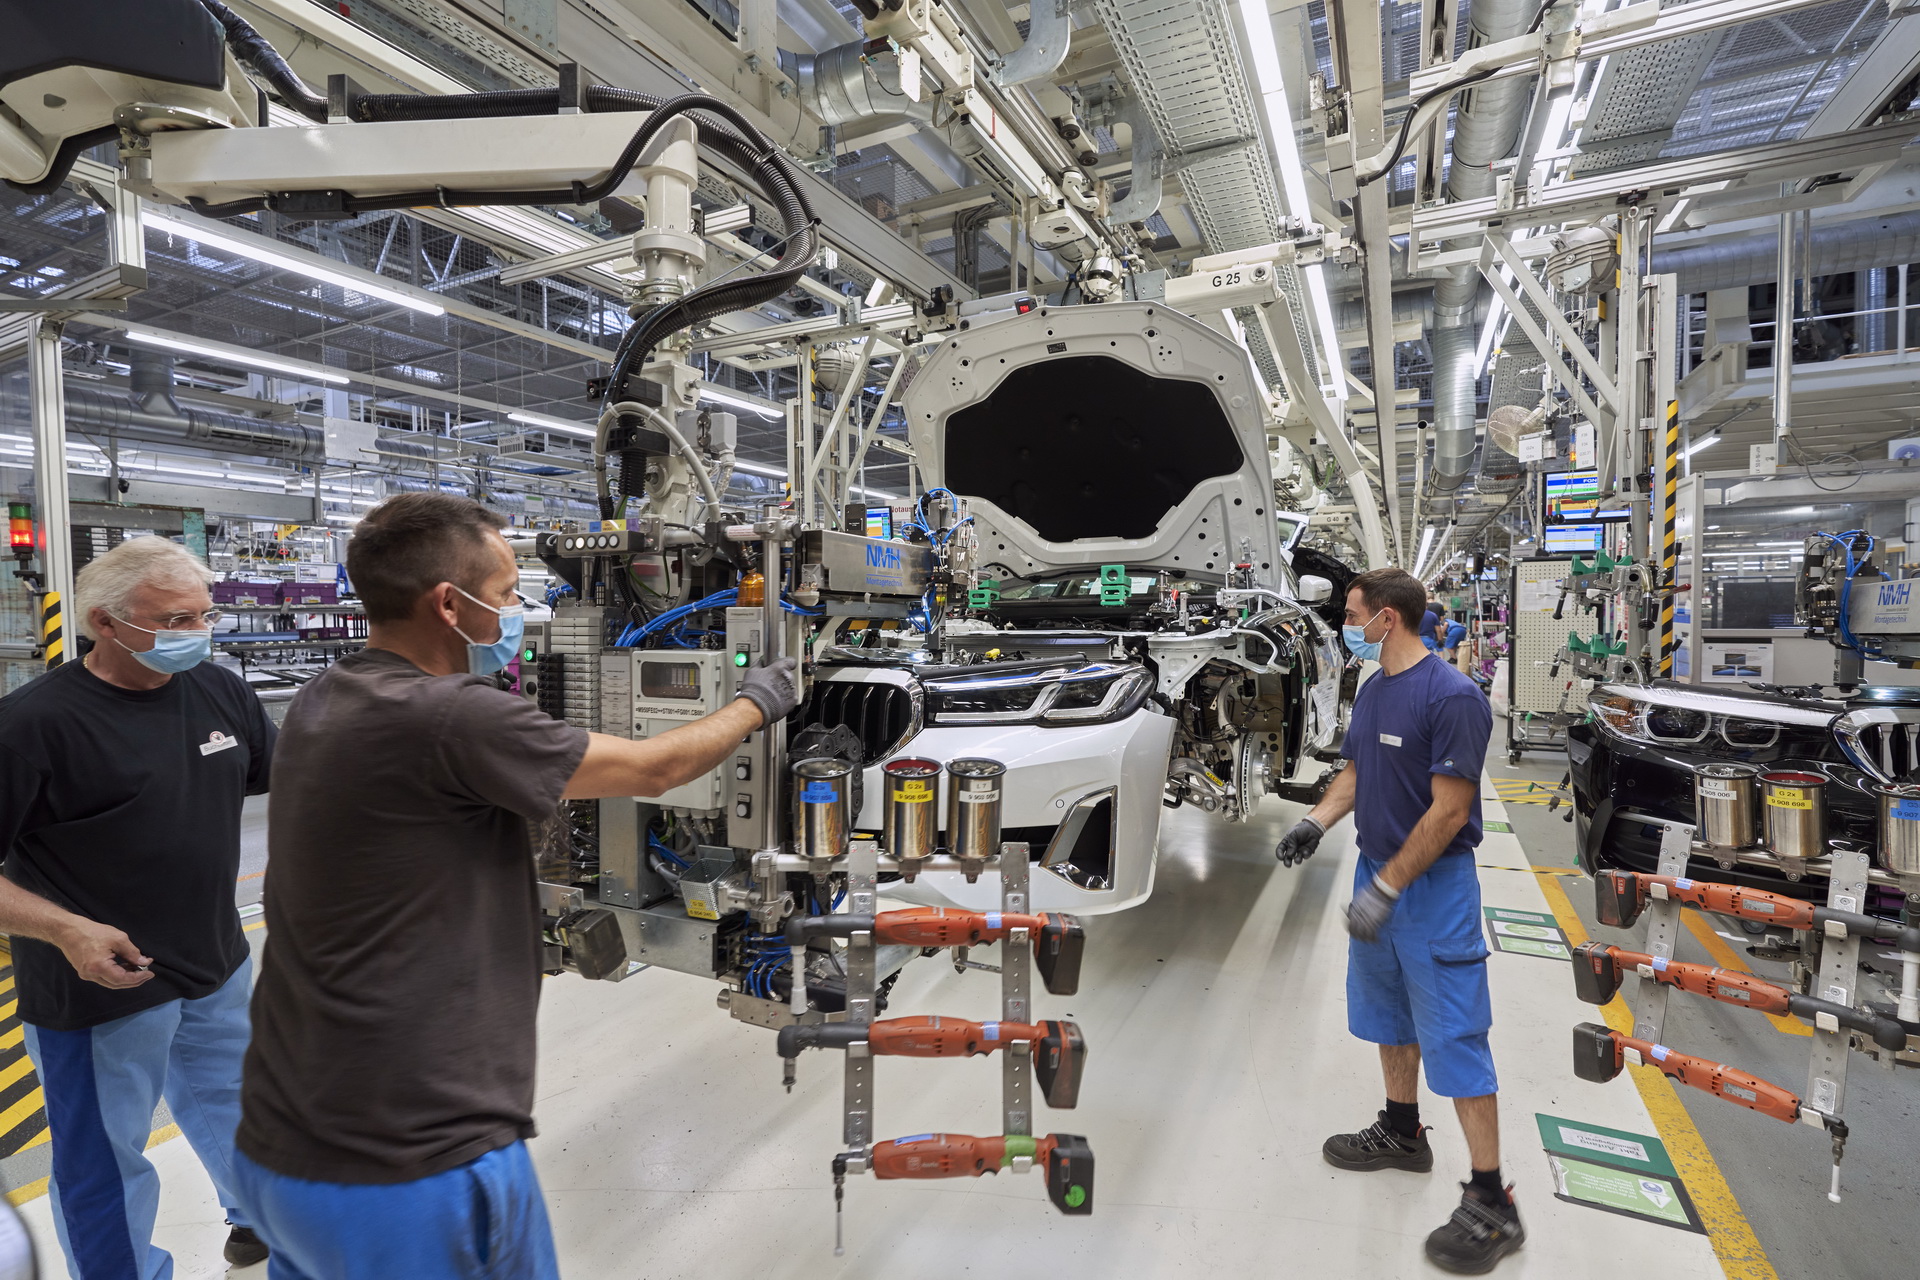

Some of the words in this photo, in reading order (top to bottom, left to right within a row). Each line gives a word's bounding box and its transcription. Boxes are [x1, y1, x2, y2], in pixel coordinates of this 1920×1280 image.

[1212, 275, 1222, 287] G
[1226, 272, 1241, 285] 25
[866, 544, 901, 569] NMH
[1877, 583, 1911, 606] NMH
[1620, 1148, 1642, 1157] Takt
